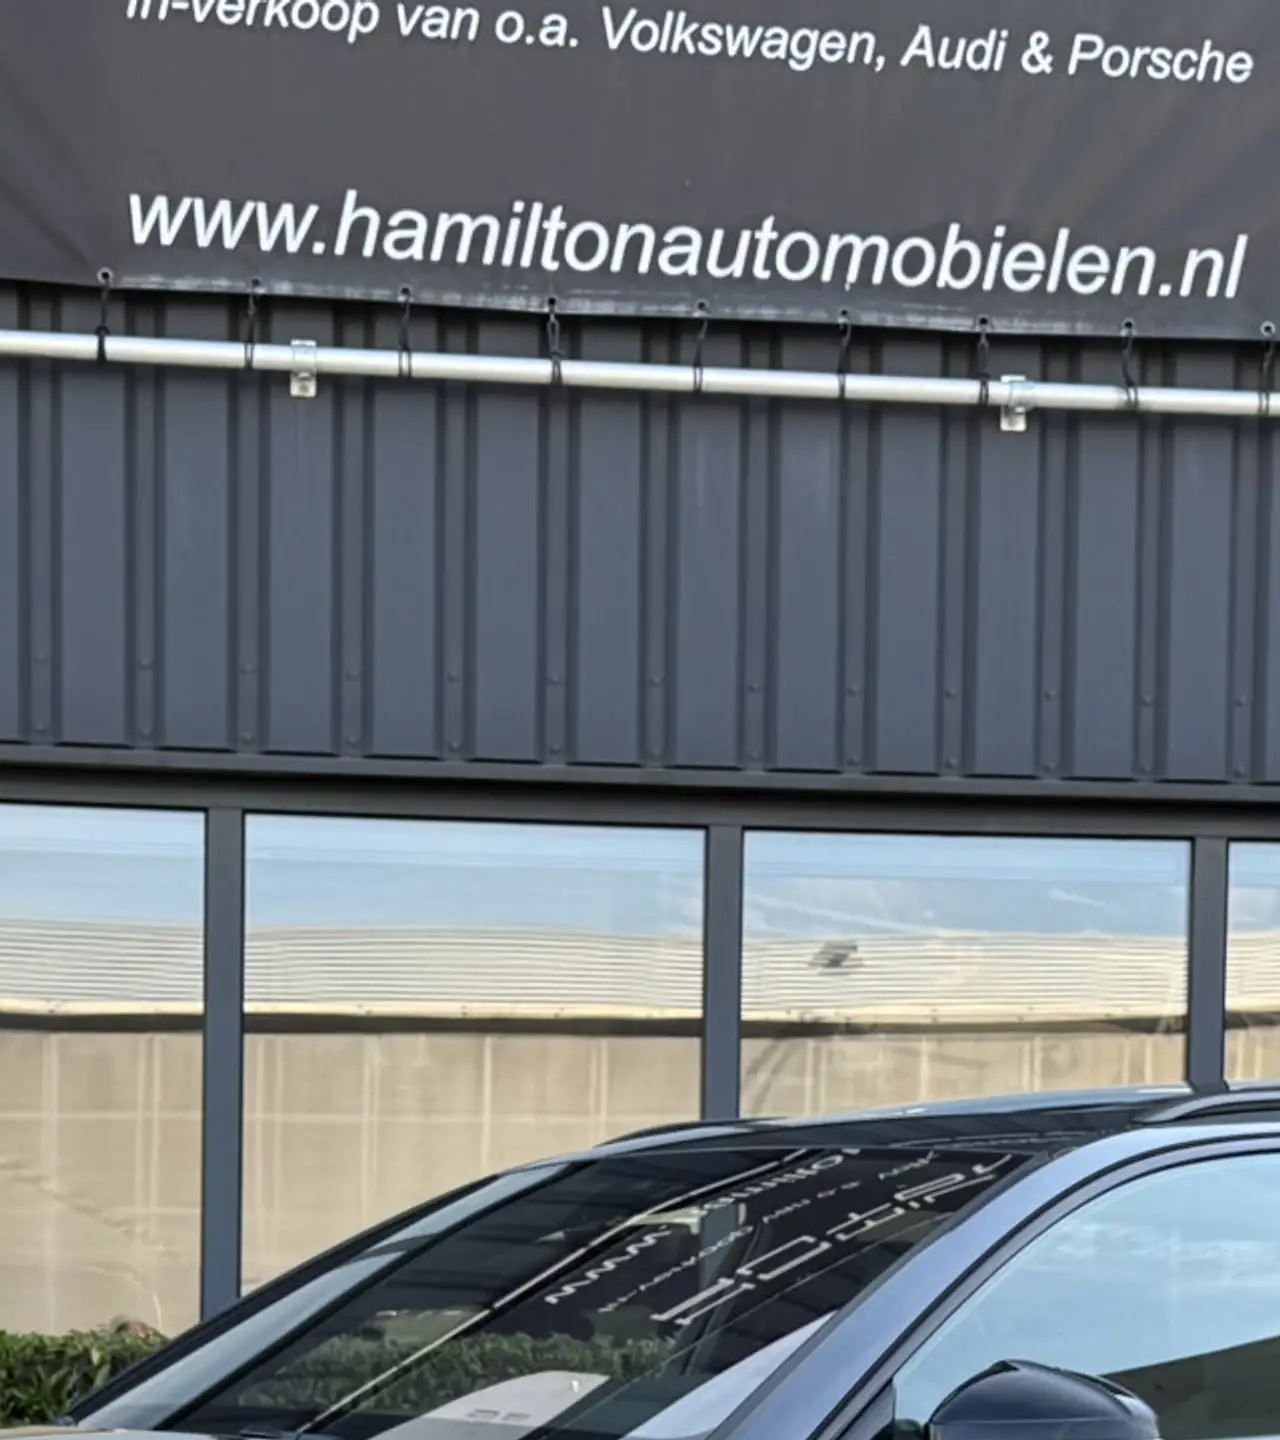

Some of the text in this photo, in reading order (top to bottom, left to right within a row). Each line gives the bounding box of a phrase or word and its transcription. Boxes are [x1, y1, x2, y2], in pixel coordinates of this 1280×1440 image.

[396, 3, 480, 41] van
[494, 10, 579, 48] o.a.
[602, 5, 886, 72] Volkswagen,
[899, 24, 1009, 72] Audi
[1020, 30, 1053, 75] &
[1067, 33, 1254, 84] Porsche
[129, 188, 1249, 299] www.hamiltonautomobielen.nl
